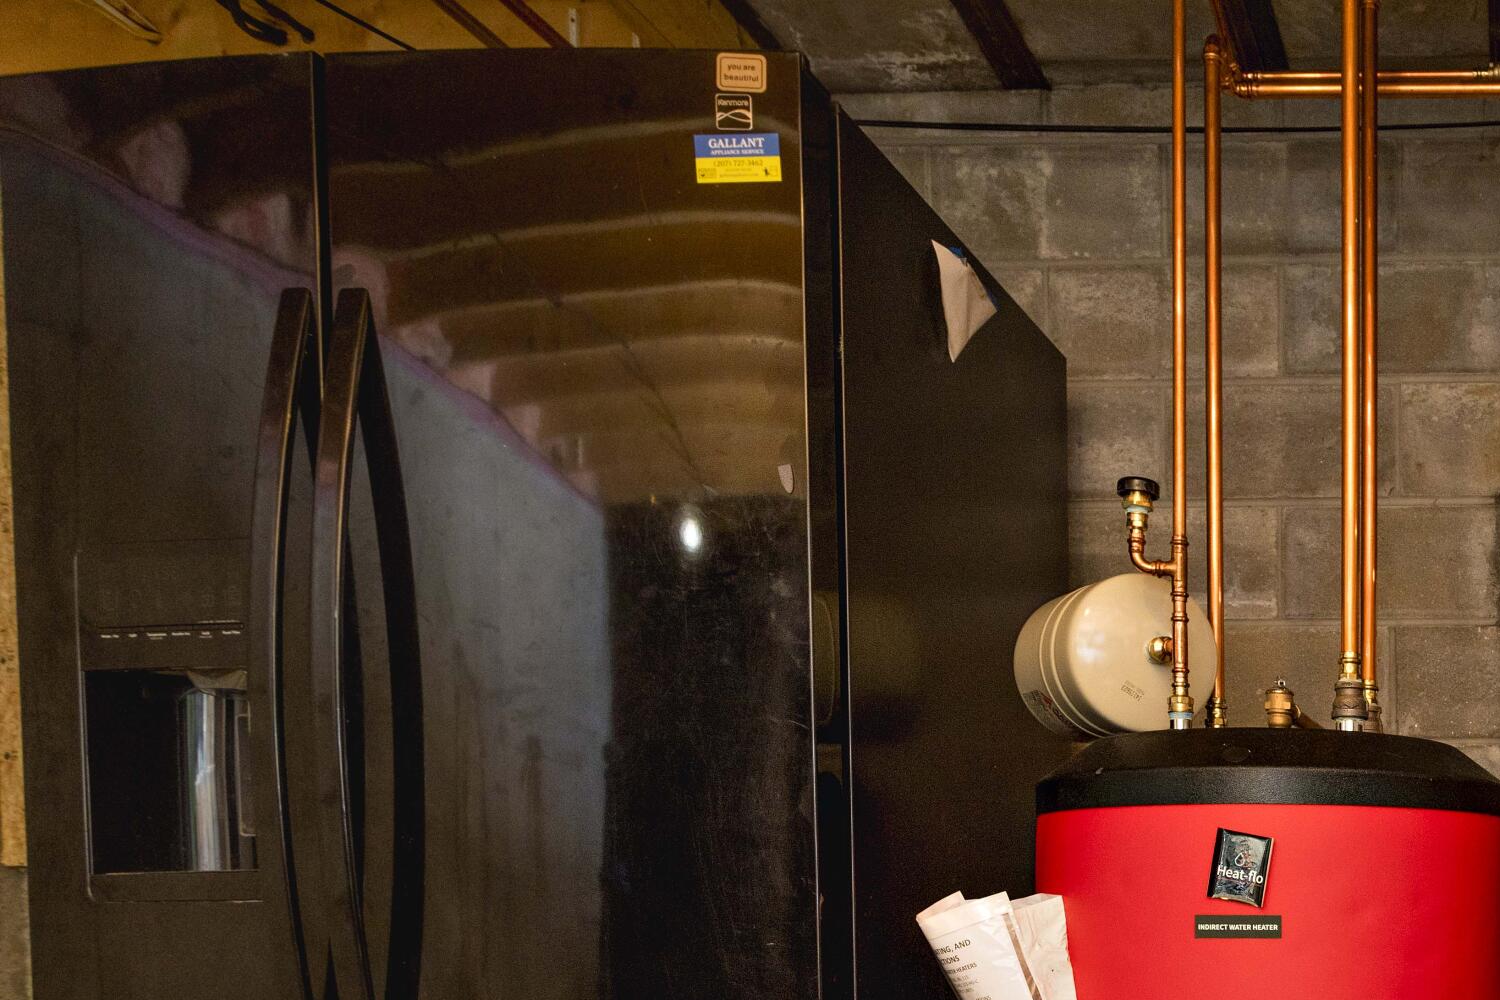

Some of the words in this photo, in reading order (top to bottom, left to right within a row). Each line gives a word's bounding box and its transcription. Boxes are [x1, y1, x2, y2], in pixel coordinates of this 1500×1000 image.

[728, 63, 741, 71] you
[724, 73, 758, 82] beautiful
[708, 137, 765, 149] GALLANT
[1217, 864, 1264, 884] Heat-flo
[954, 939, 971, 950] AND
